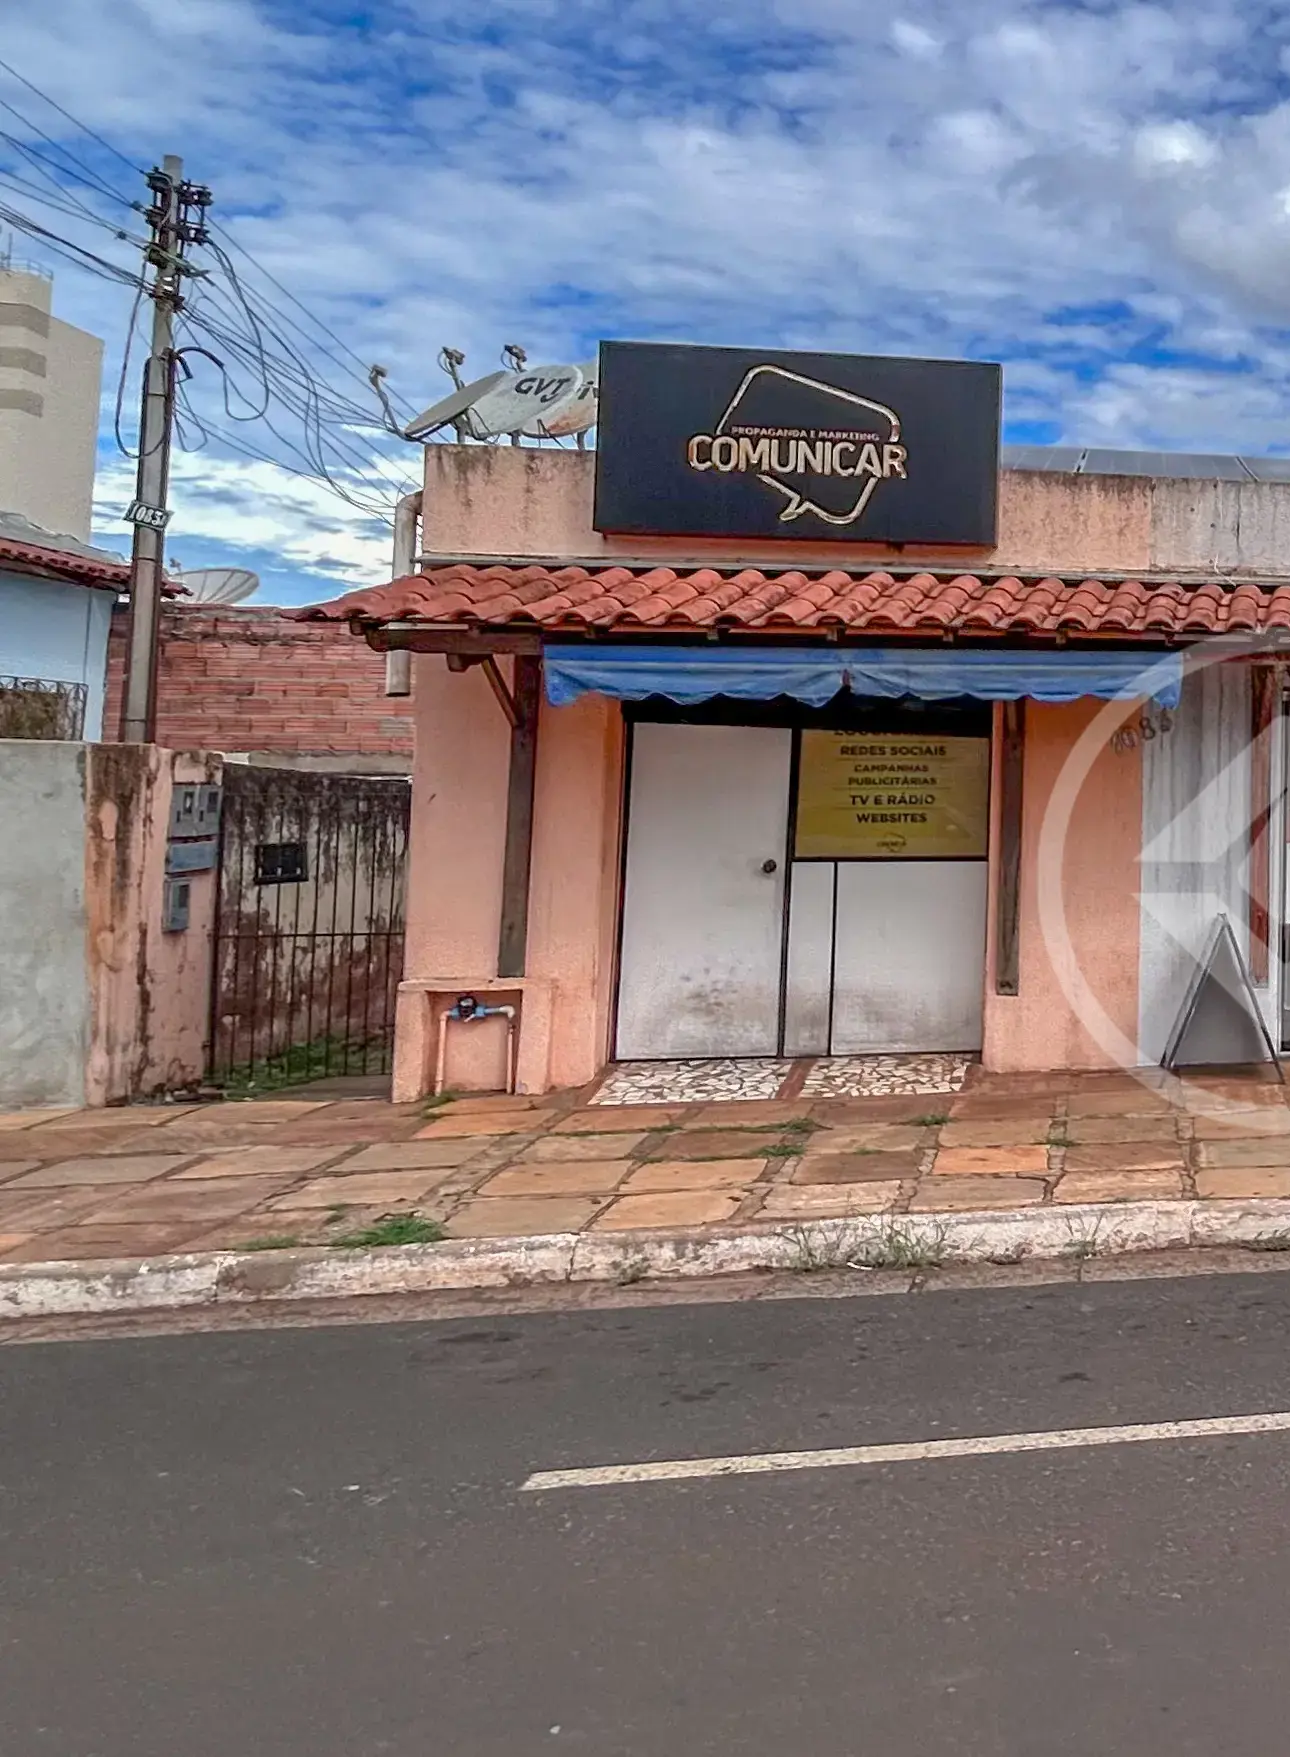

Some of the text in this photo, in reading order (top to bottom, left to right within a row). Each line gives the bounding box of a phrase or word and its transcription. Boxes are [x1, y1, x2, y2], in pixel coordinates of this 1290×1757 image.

[730, 426, 880, 442] PROPAGANDA E MARKETING
[688, 434, 908, 480] COMUNICAR
[840, 745, 947, 756] REDES SOCIAIS
[854, 764, 929, 773] CAMPANHAS
[848, 775, 937, 785] PUBLICITÁRIAS
[849, 792, 936, 806] TV E RÁDIO
[856, 813, 927, 823] WEBSITES
